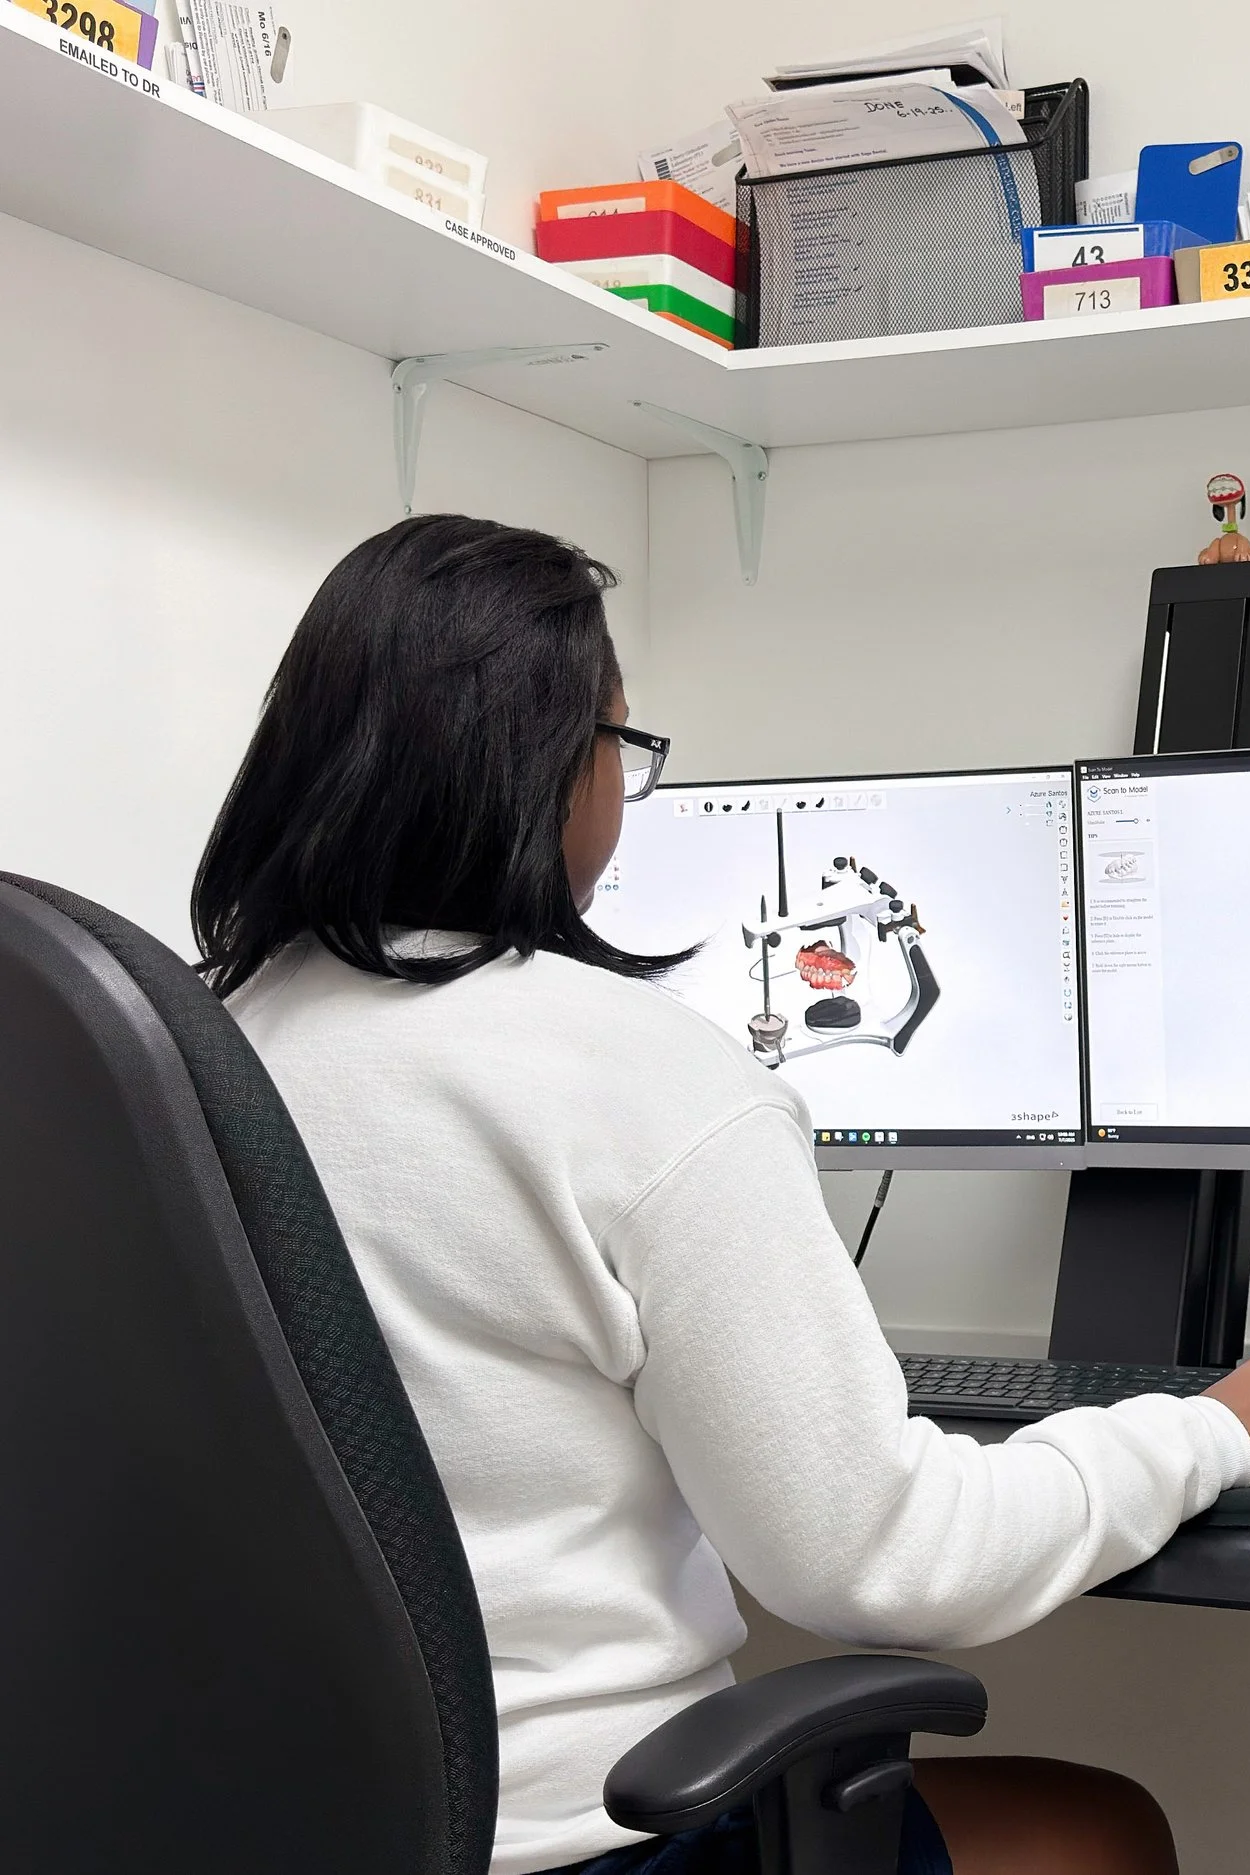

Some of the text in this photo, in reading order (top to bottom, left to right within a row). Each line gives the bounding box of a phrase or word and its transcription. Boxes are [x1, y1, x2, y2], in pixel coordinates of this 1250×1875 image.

[257, 10, 267, 29] Mo
[261, 31, 272, 57] 6/16
[60, 39, 160, 98] EMAILED TO DR
[864, 101, 904, 113] DONE
[445, 219, 516, 261] CASE APPROVED
[1071, 245, 1106, 268] 43
[1075, 290, 1111, 311] 713
[1103, 787, 1120, 795] Scan
[1011, 1112, 1051, 1122] 3shape
